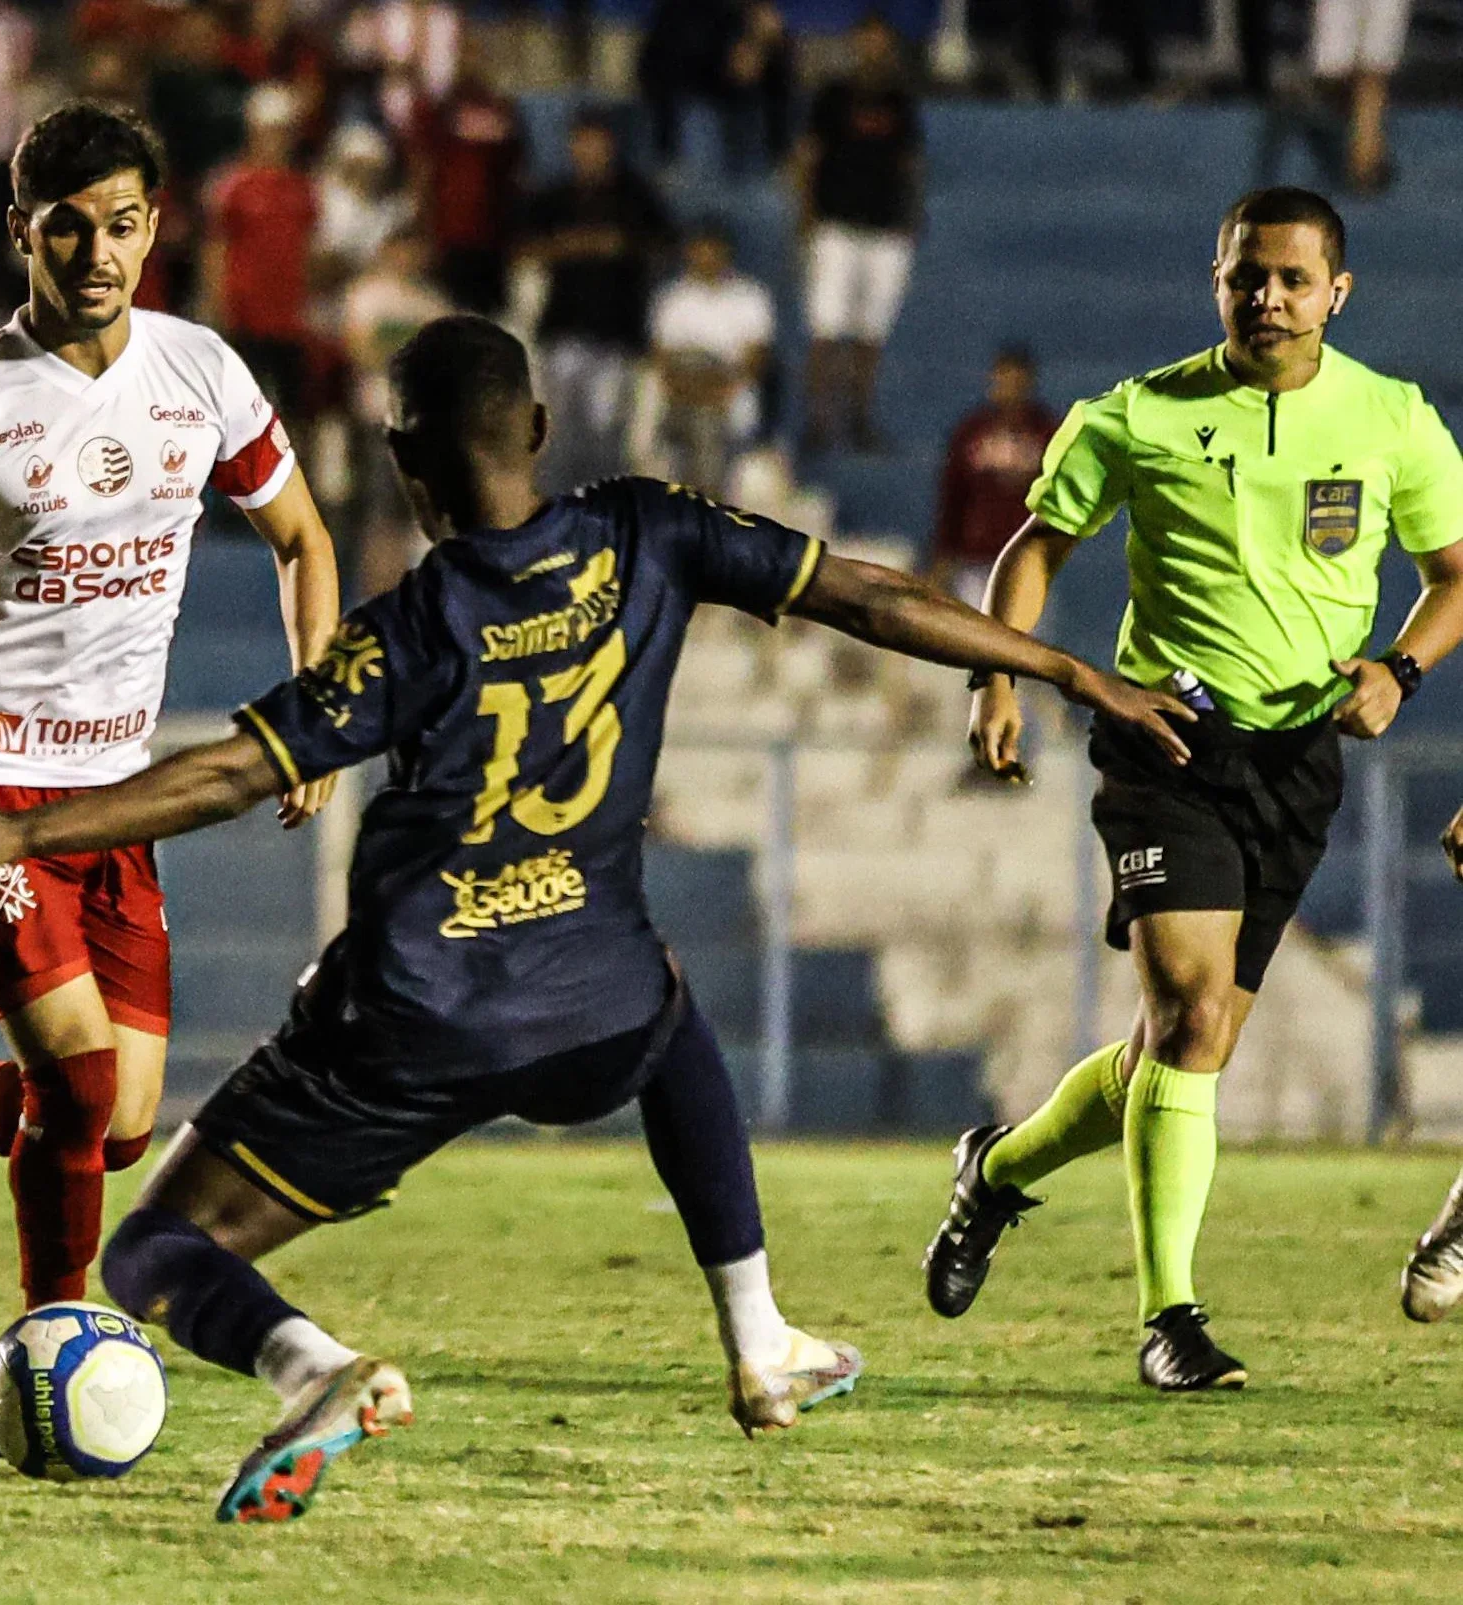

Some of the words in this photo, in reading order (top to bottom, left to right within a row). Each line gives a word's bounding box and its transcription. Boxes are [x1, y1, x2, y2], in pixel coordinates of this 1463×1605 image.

[149, 404, 206, 422] Geolab
[150, 485, 174, 500] SÃO
[15, 572, 66, 604] da
[72, 568, 167, 605] Sorte
[36, 708, 147, 745] TOPFIELD
[461, 628, 628, 845] 13
[1118, 846, 1164, 875] CBF
